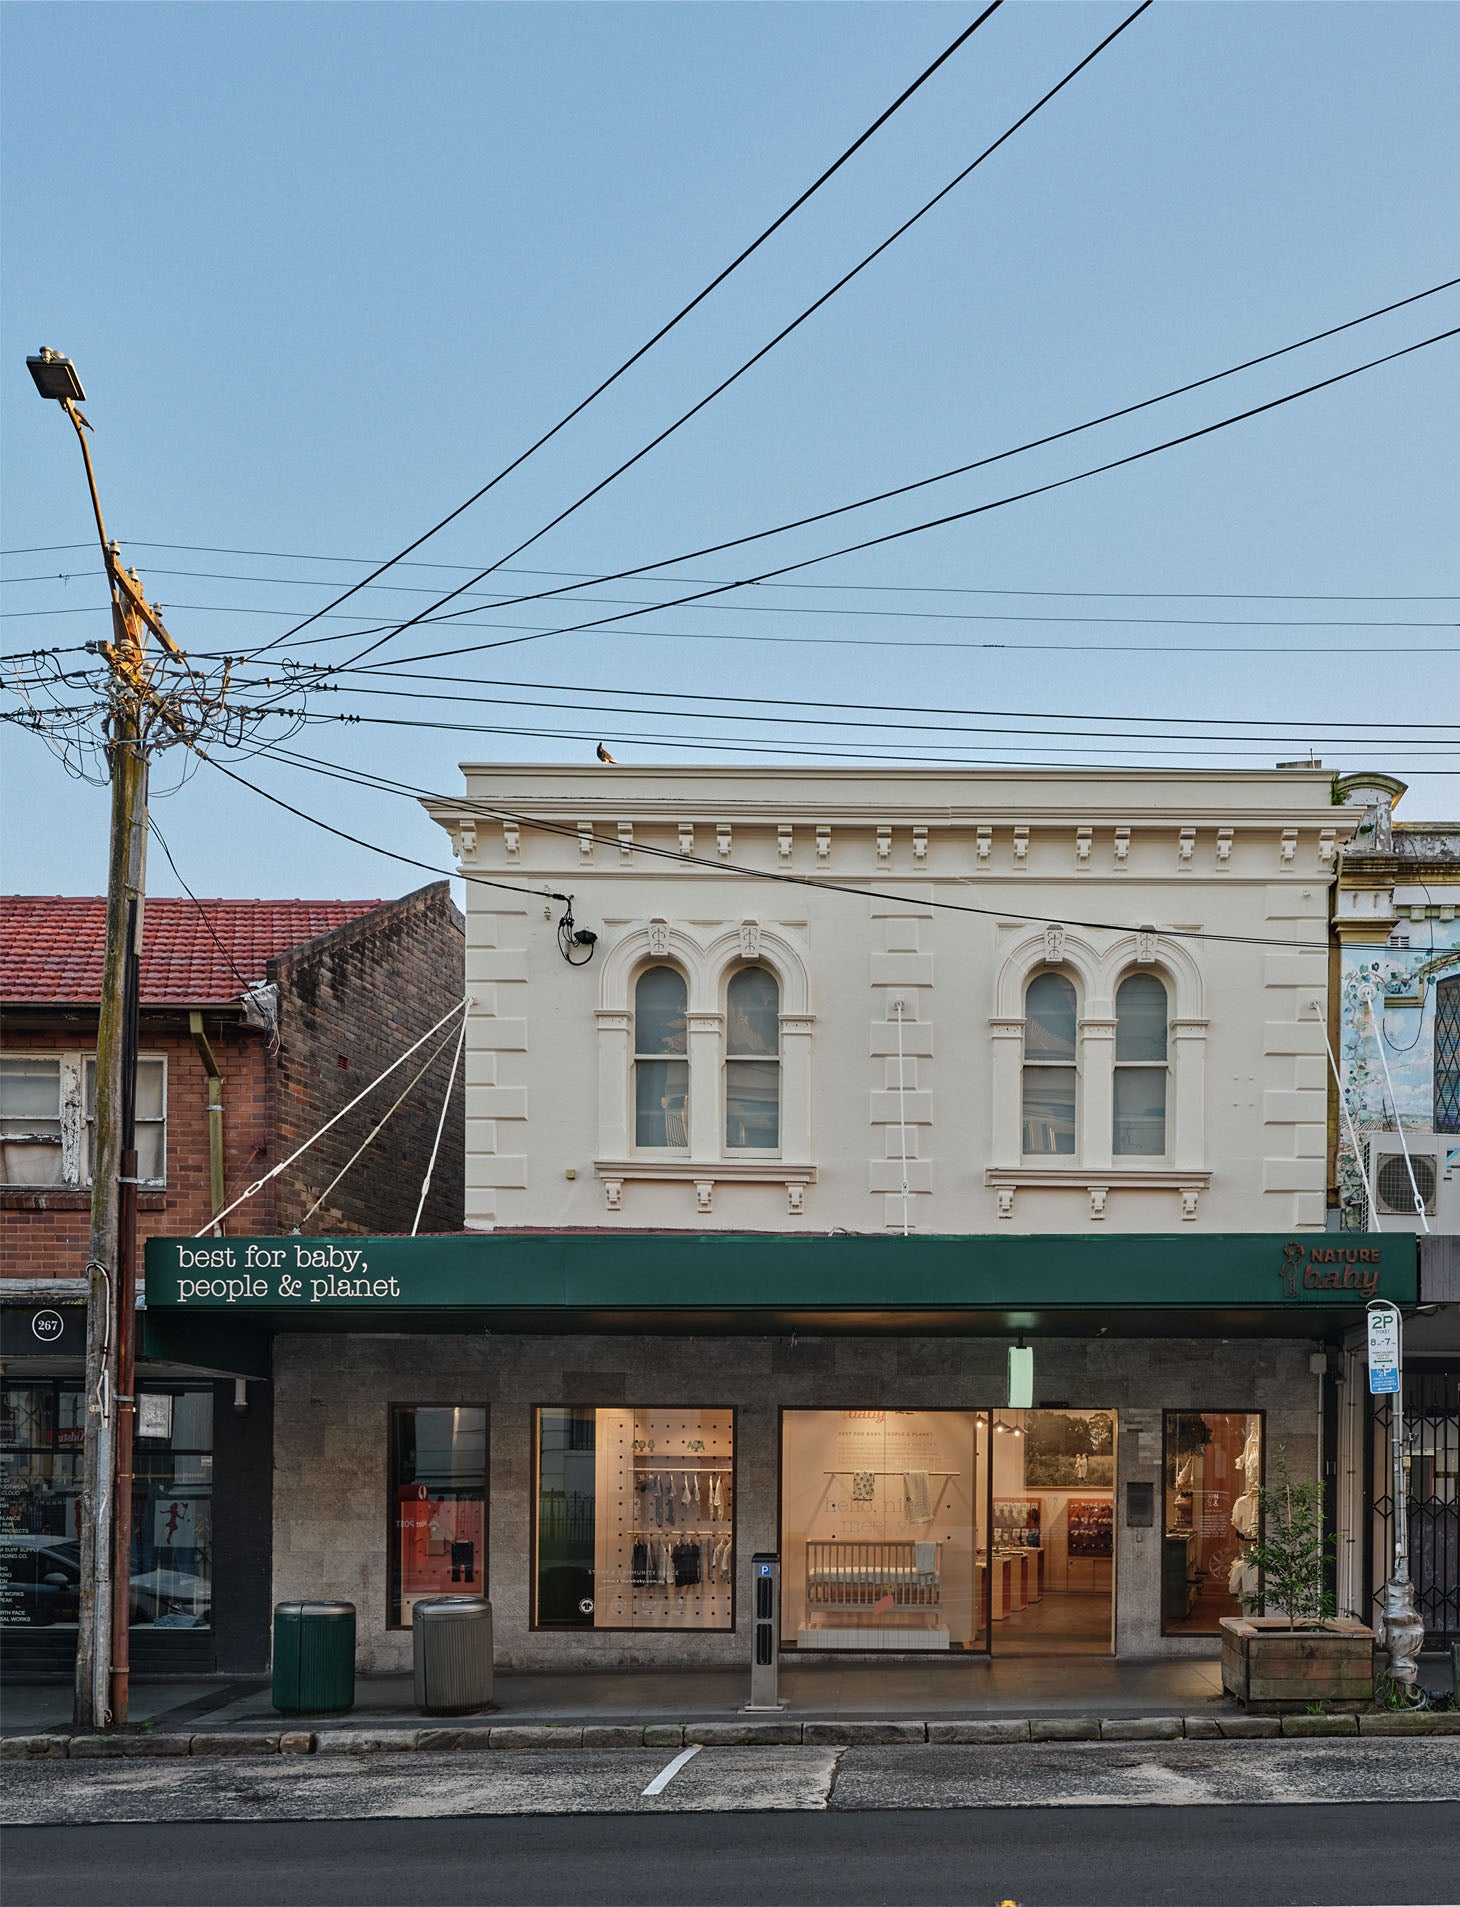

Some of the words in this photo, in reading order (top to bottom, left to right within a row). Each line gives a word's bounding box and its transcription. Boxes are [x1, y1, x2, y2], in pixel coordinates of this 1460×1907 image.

[176, 1245, 237, 1268] best
[244, 1245, 287, 1268] for
[294, 1245, 368, 1273] baby,
[1311, 1248, 1380, 1263] NATURE
[176, 1274, 268, 1303] people
[278, 1274, 302, 1297] &
[310, 1274, 400, 1303] planet
[1303, 1263, 1379, 1298] baby
[38, 1320, 58, 1331] 267
[1372, 1315, 1394, 1330] 2P
